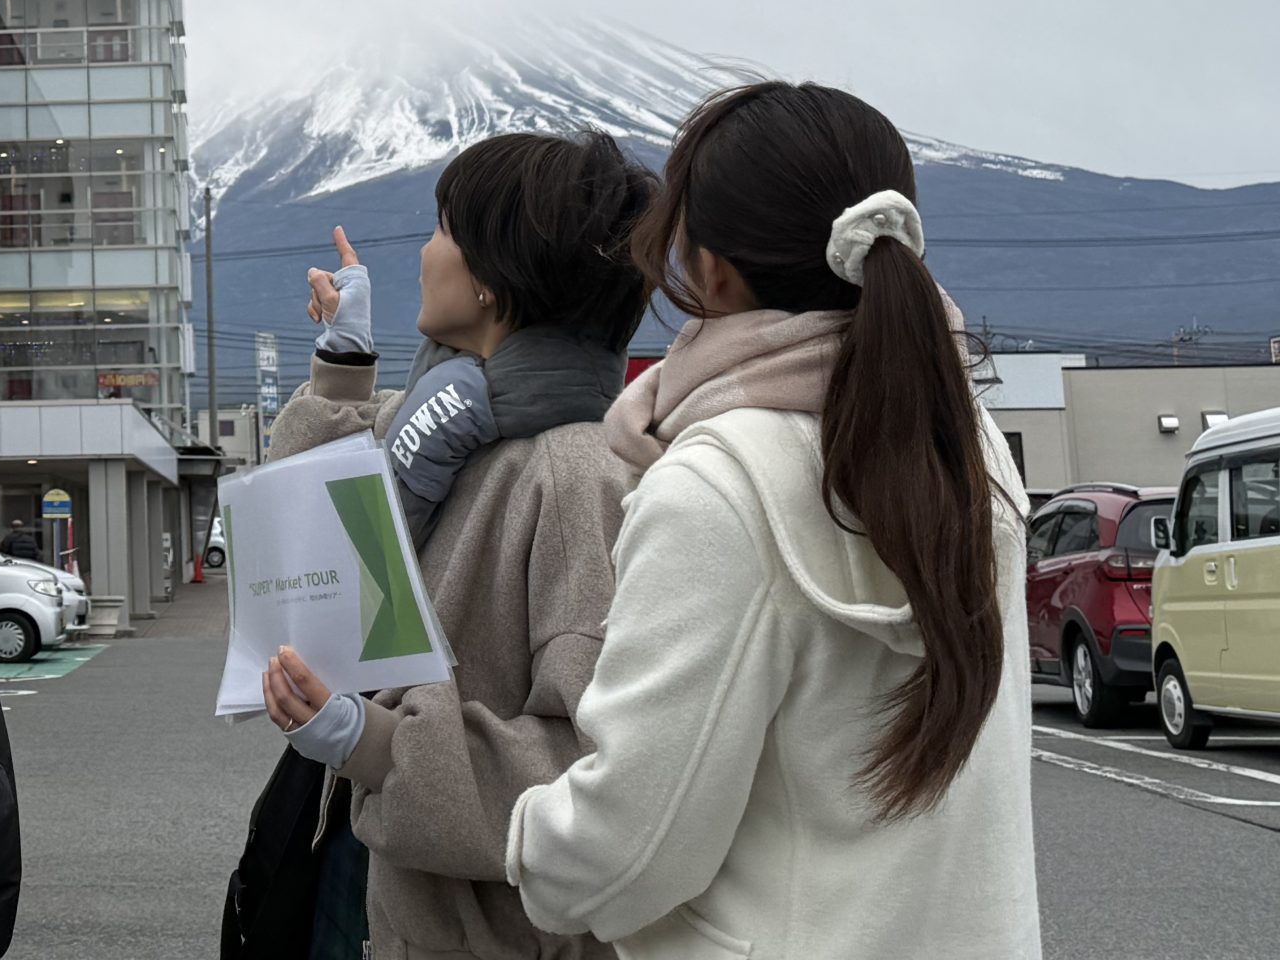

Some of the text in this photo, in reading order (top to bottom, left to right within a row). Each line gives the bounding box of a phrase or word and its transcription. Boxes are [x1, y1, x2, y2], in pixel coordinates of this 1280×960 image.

[391, 383, 466, 469] EDWIN
[275, 575, 303, 592] Market
[304, 569, 340, 587] TOUR
